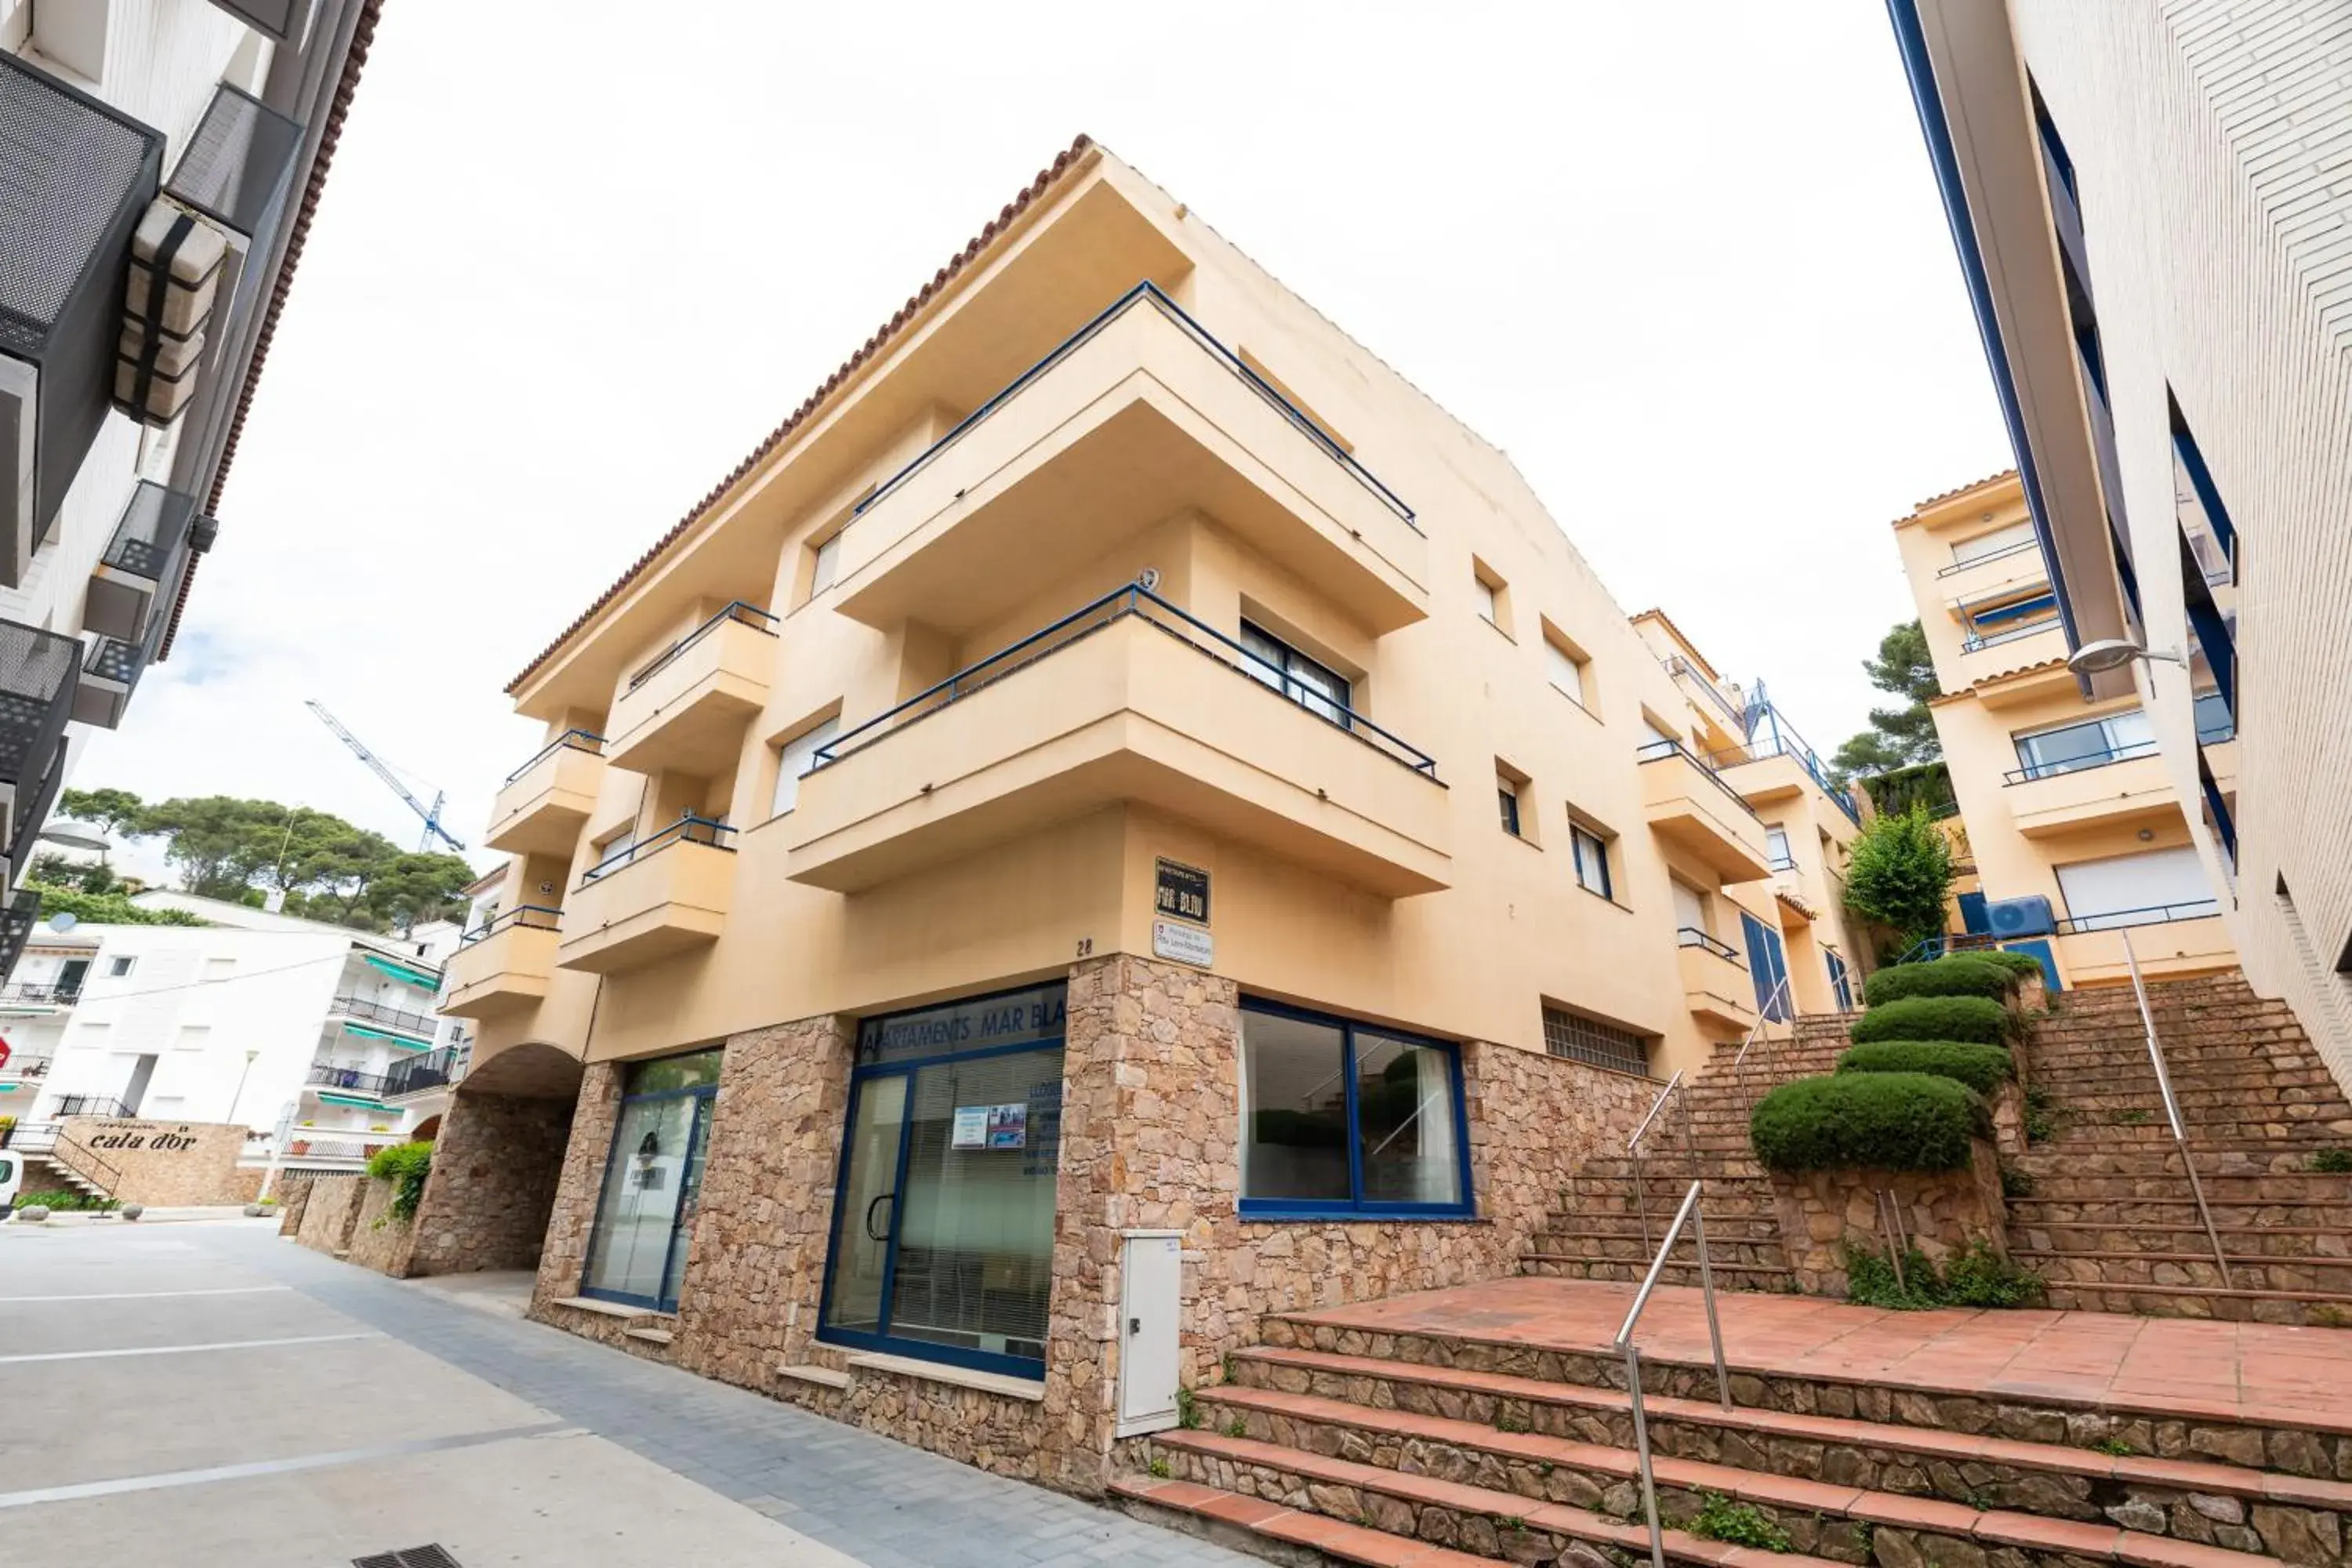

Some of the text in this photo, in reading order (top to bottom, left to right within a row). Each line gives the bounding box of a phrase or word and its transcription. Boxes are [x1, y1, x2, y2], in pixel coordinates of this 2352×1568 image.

[864, 1016, 971, 1054] APARTAMENTS
[980, 1007, 1024, 1036] MAR
[90, 1131, 145, 1149] cala
